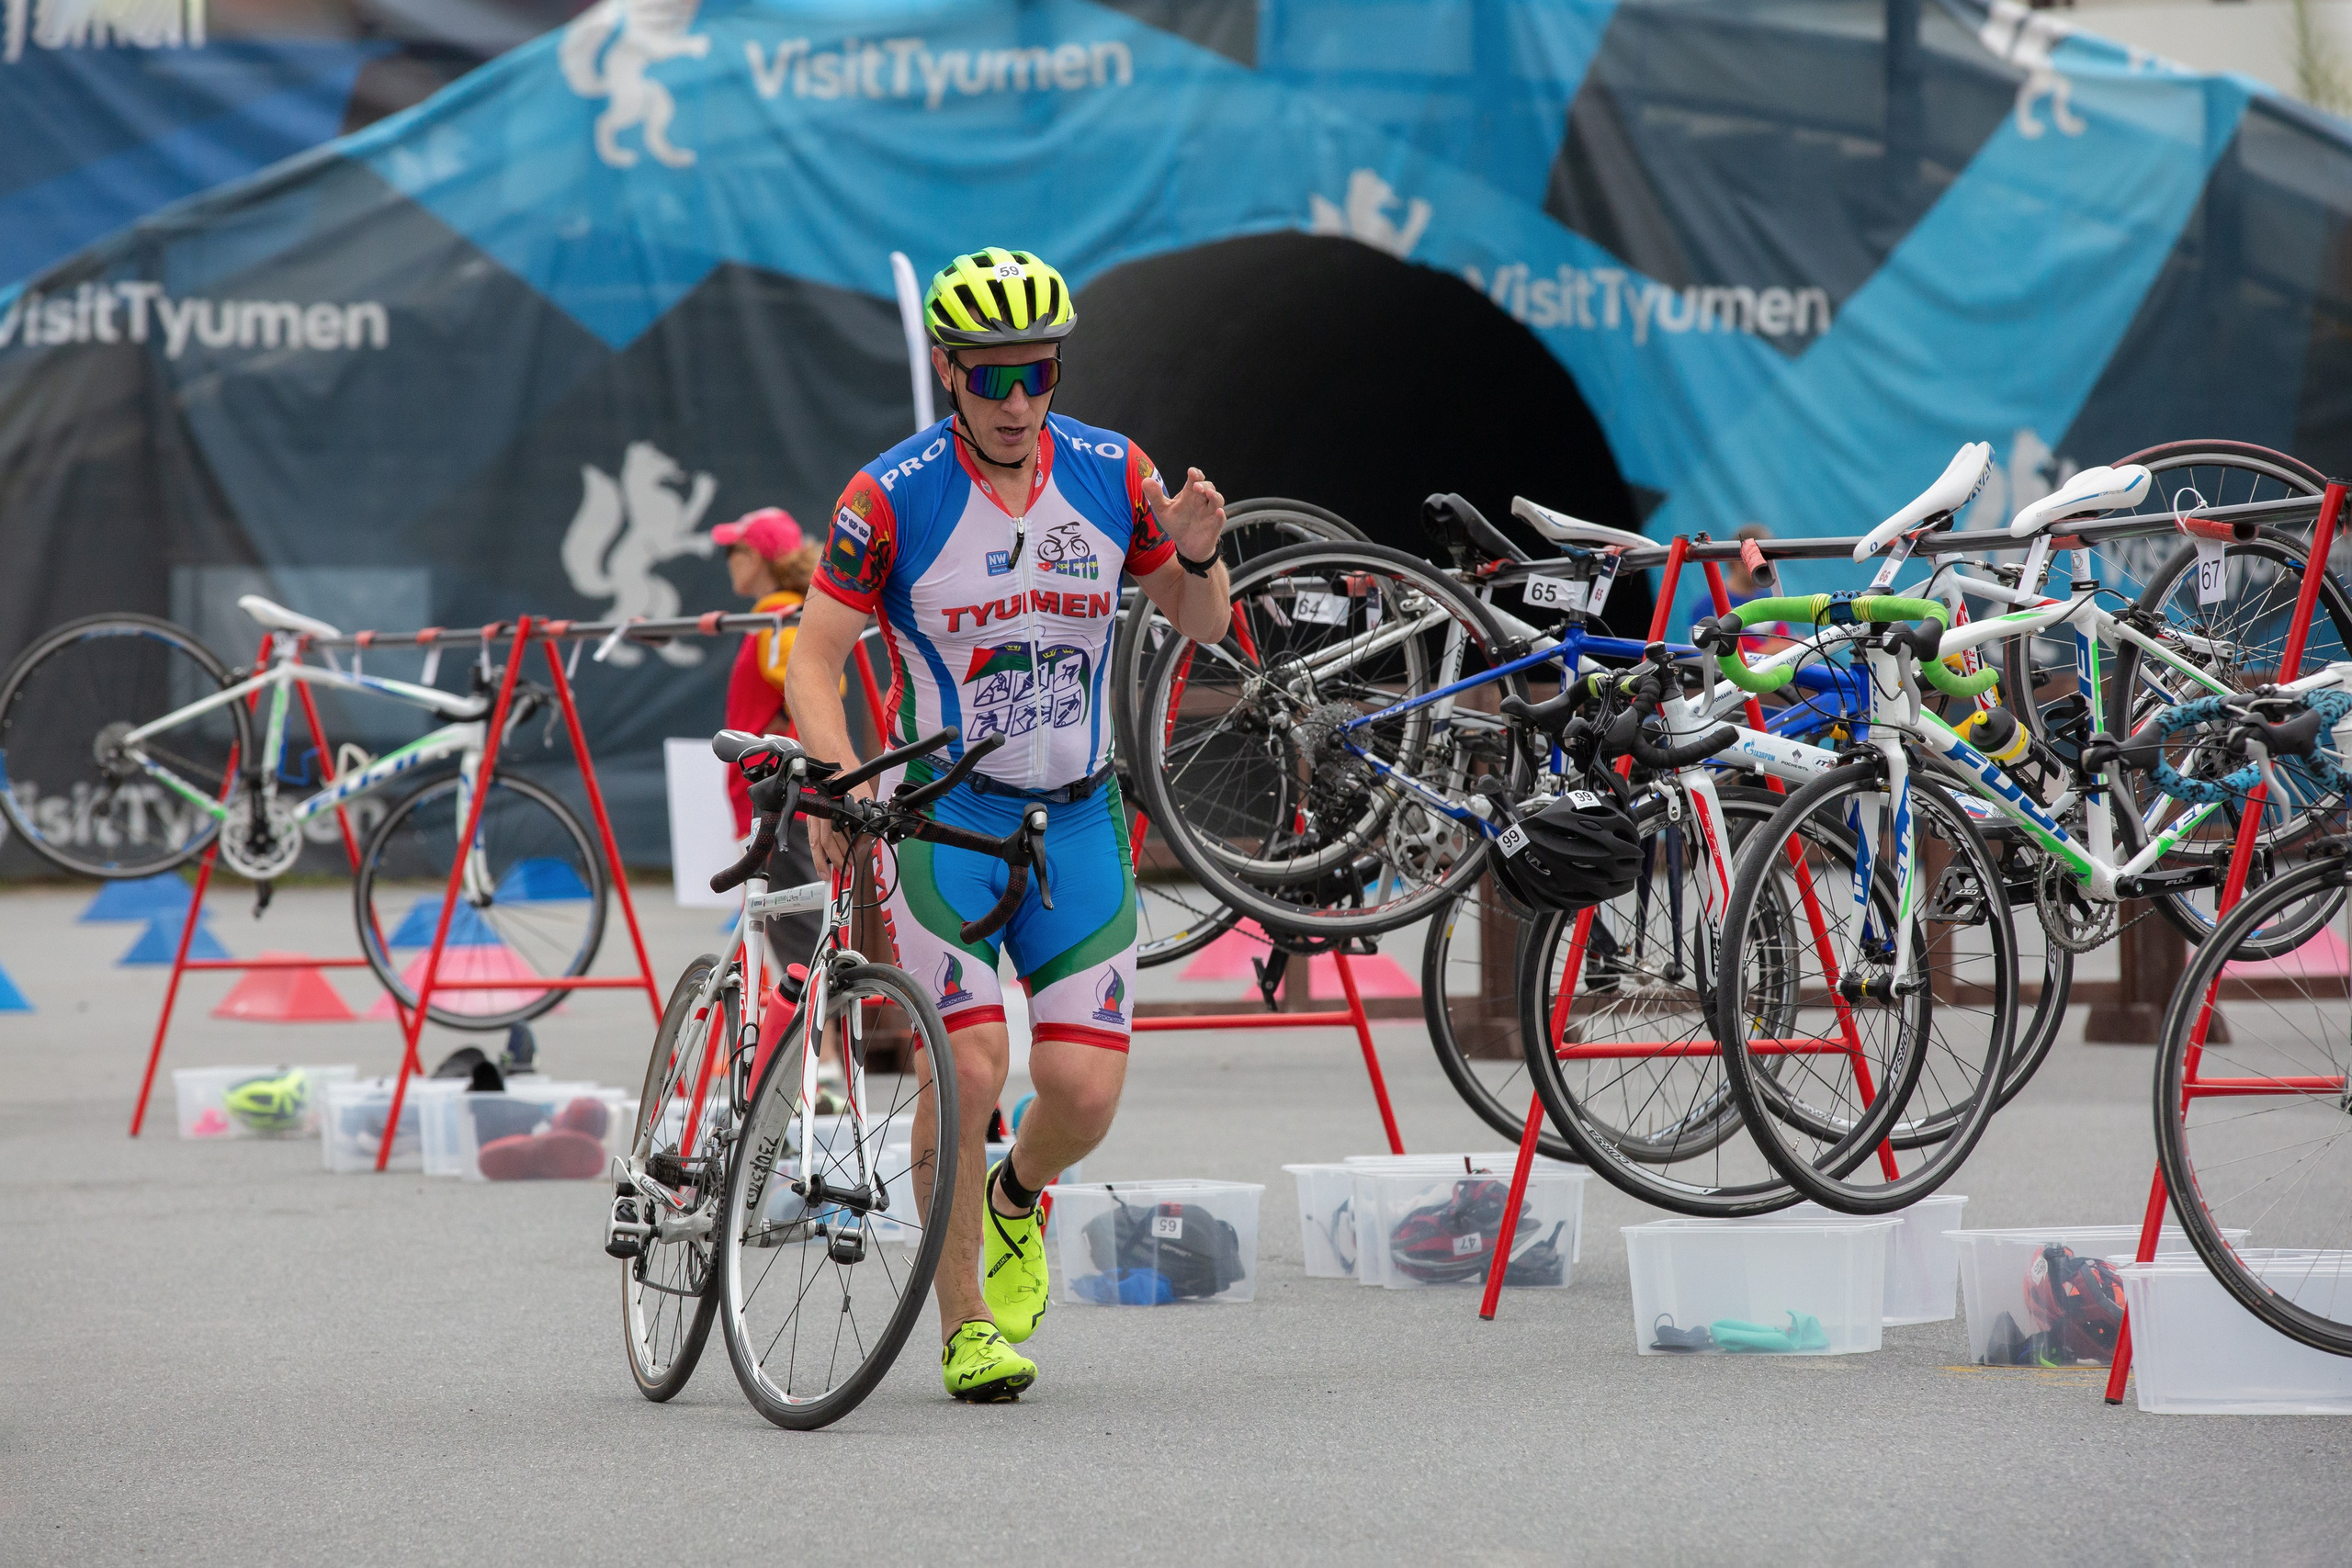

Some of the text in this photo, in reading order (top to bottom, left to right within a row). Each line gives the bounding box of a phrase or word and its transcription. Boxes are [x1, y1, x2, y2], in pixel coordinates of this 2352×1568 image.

[747, 40, 1132, 108] VisitTyumen
[1000, 266, 1020, 276] 59
[880, 438, 947, 491] PRO
[2201, 559, 2221, 591] 67
[1532, 582, 1557, 603] 65
[942, 591, 1110, 633] TYUMEN
[1297, 598, 1321, 617] 64
[1575, 792, 1593, 803] 99
[1945, 739, 2069, 843] FUJI
[1502, 829, 1520, 848] 99
[2165, 875, 2195, 887] FUJI
[1894, 1024, 1911, 1075] CORSA
[1589, 1128, 1631, 1166] CORSA
[1159, 1219, 1176, 1233] 65
[1460, 1236, 1477, 1250] 47
